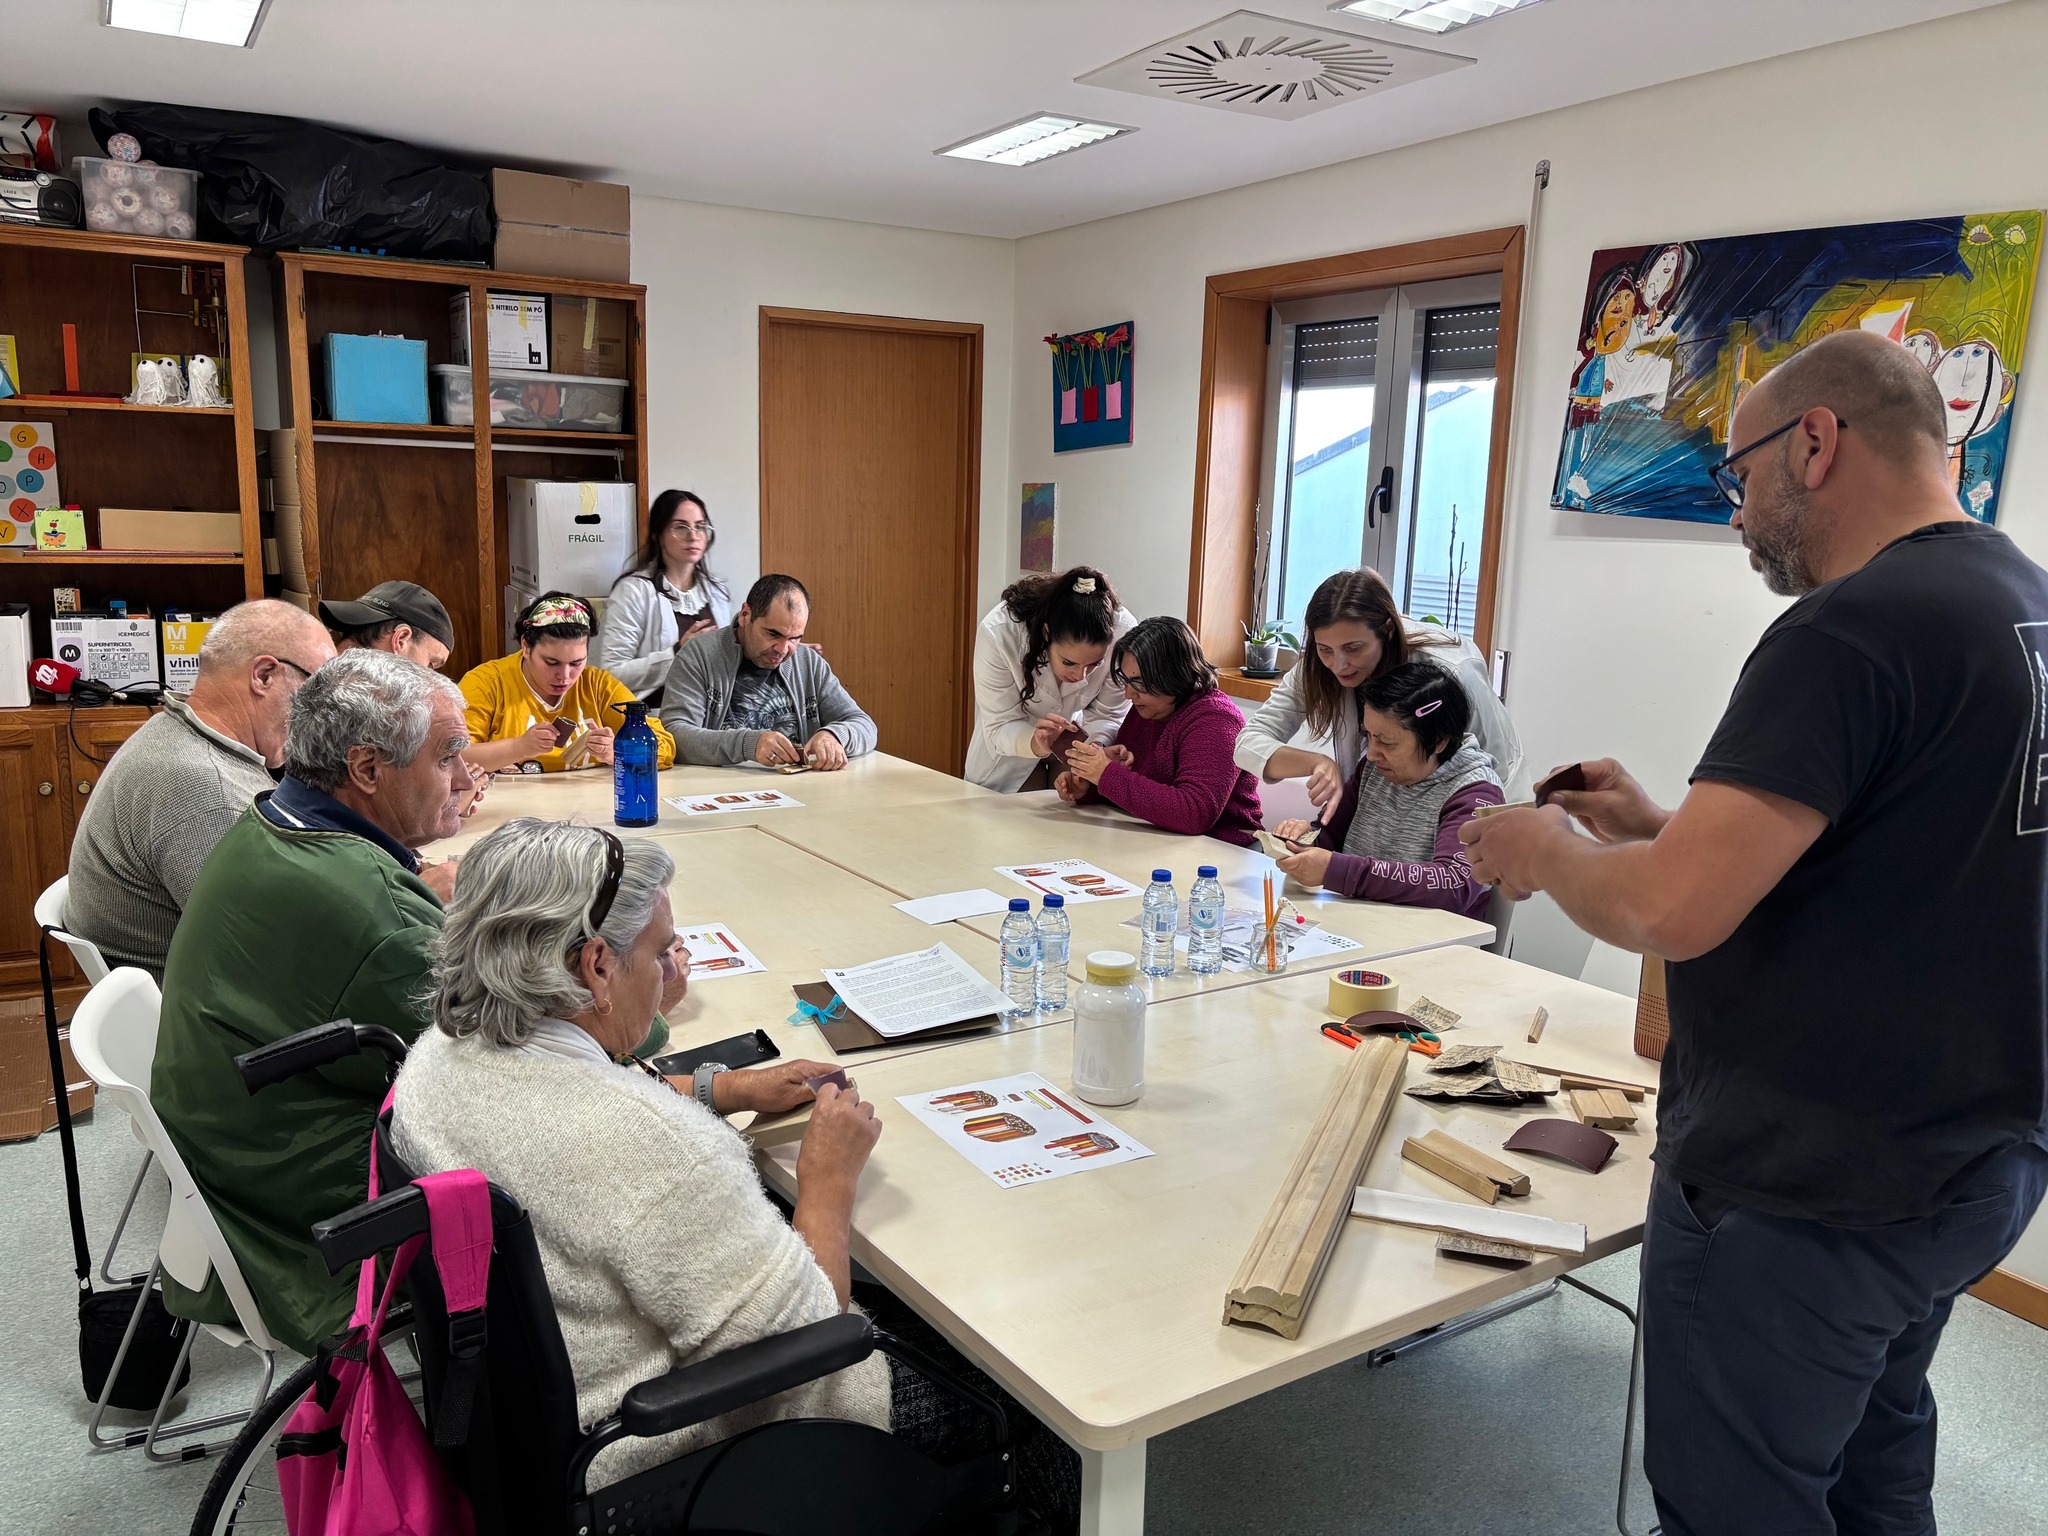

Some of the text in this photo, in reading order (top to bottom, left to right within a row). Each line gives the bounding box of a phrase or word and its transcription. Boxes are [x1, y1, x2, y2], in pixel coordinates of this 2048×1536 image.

[496, 304, 519, 312] NITRILO
[17, 430, 27, 443] G
[38, 453, 46, 465] H
[25, 475, 34, 487] P
[16, 504, 30, 518] X
[568, 532, 605, 543] FRÁGIL
[167, 625, 187, 641] M
[65, 649, 76, 658] M
[1365, 976, 1381, 984] tesa
